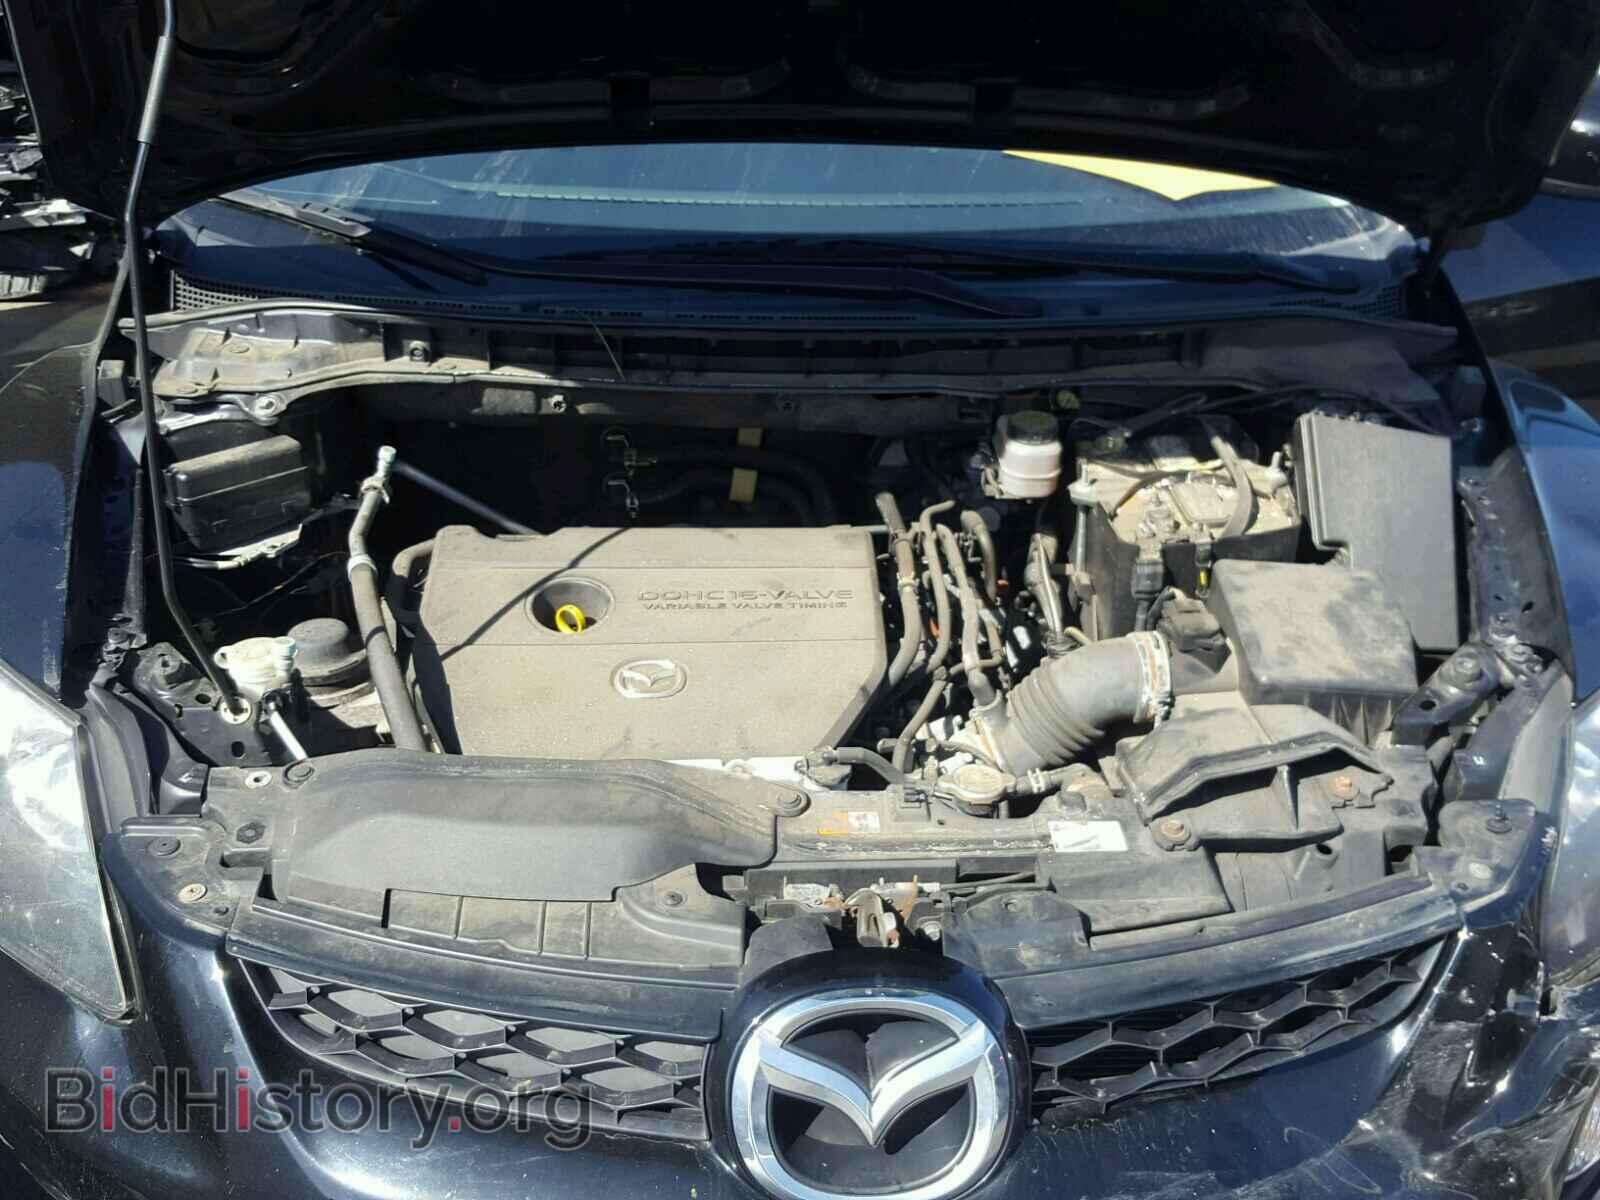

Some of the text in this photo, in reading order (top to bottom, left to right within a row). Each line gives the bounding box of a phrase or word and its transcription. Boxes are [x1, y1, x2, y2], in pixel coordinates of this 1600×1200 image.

[638, 590, 726, 601] DOHC
[642, 601, 848, 611] VARIABLE VALVE TIMING
